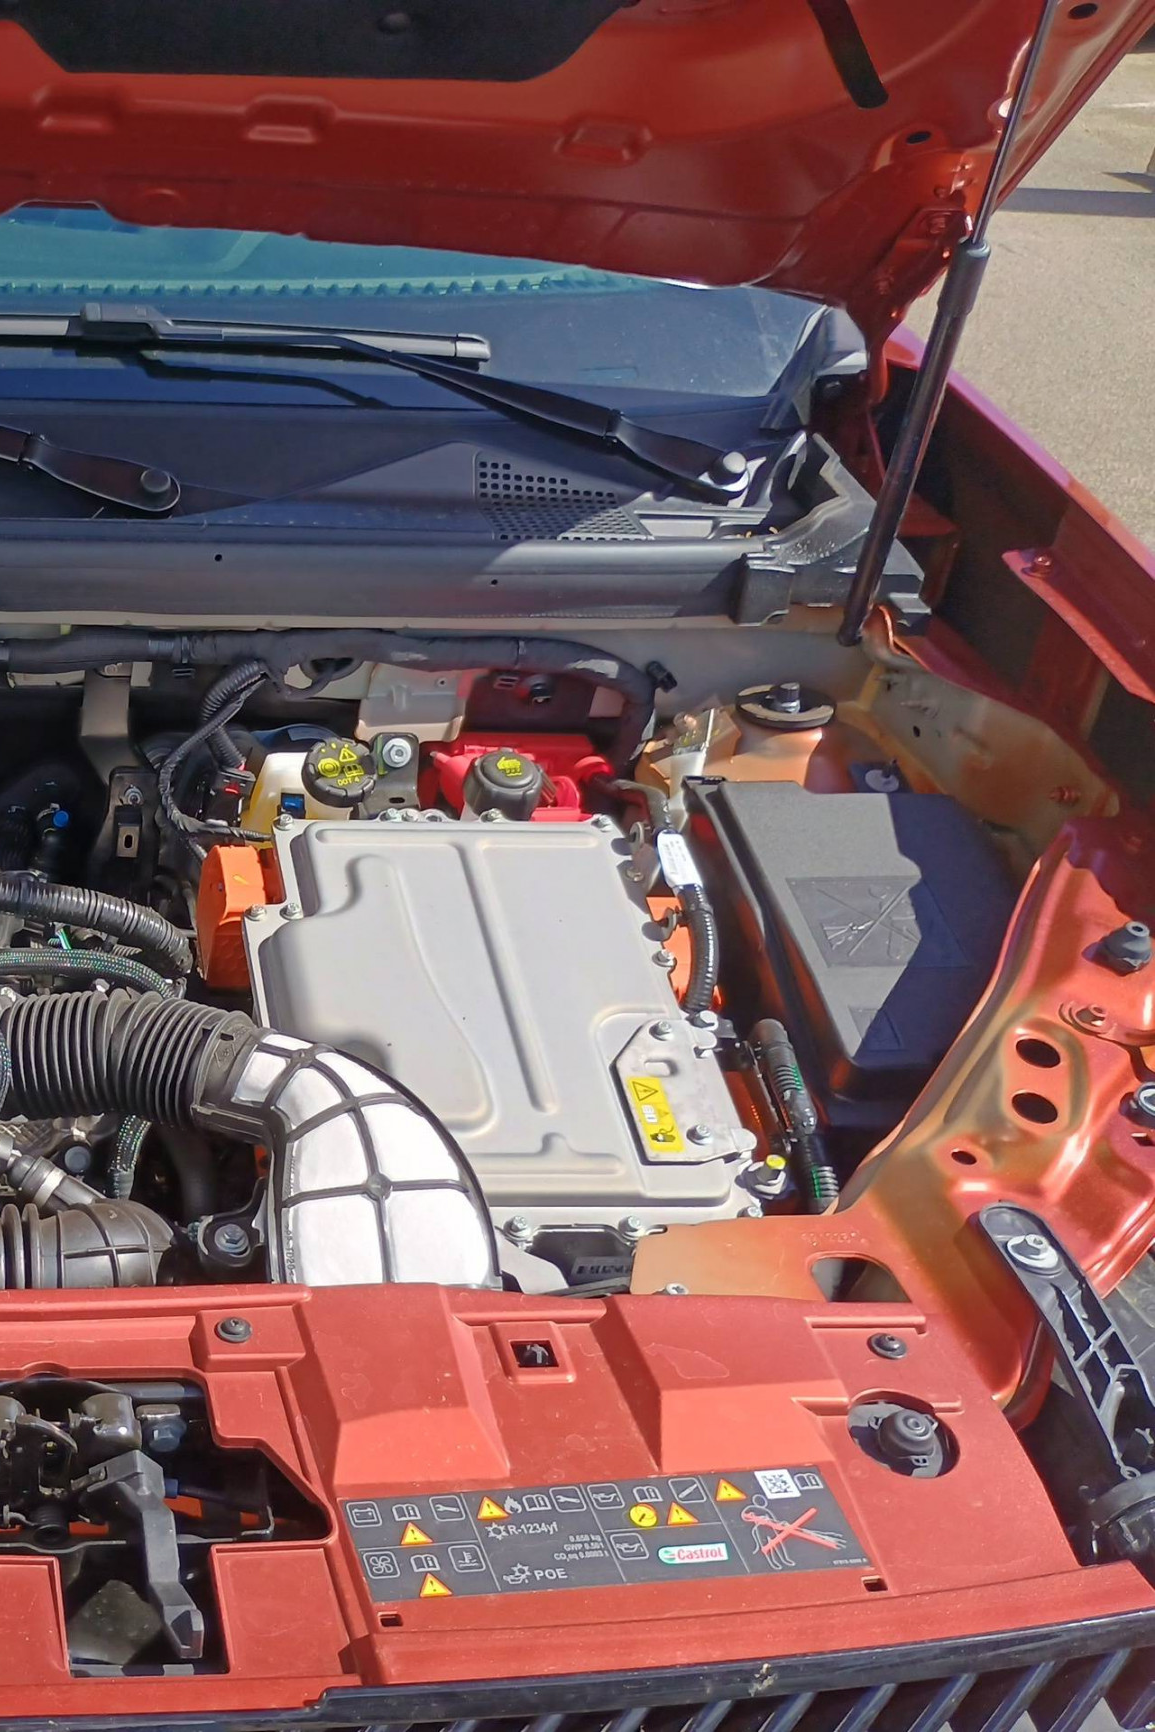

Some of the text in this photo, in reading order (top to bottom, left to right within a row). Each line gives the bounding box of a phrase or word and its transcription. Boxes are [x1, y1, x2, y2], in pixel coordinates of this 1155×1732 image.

[337, 777, 352, 786] DOT
[507, 1521, 559, 1535] R-1234yf
[563, 1543, 583, 1551] GWP
[676, 1545, 724, 1561] Castrol
[533, 1567, 568, 1581] POE
